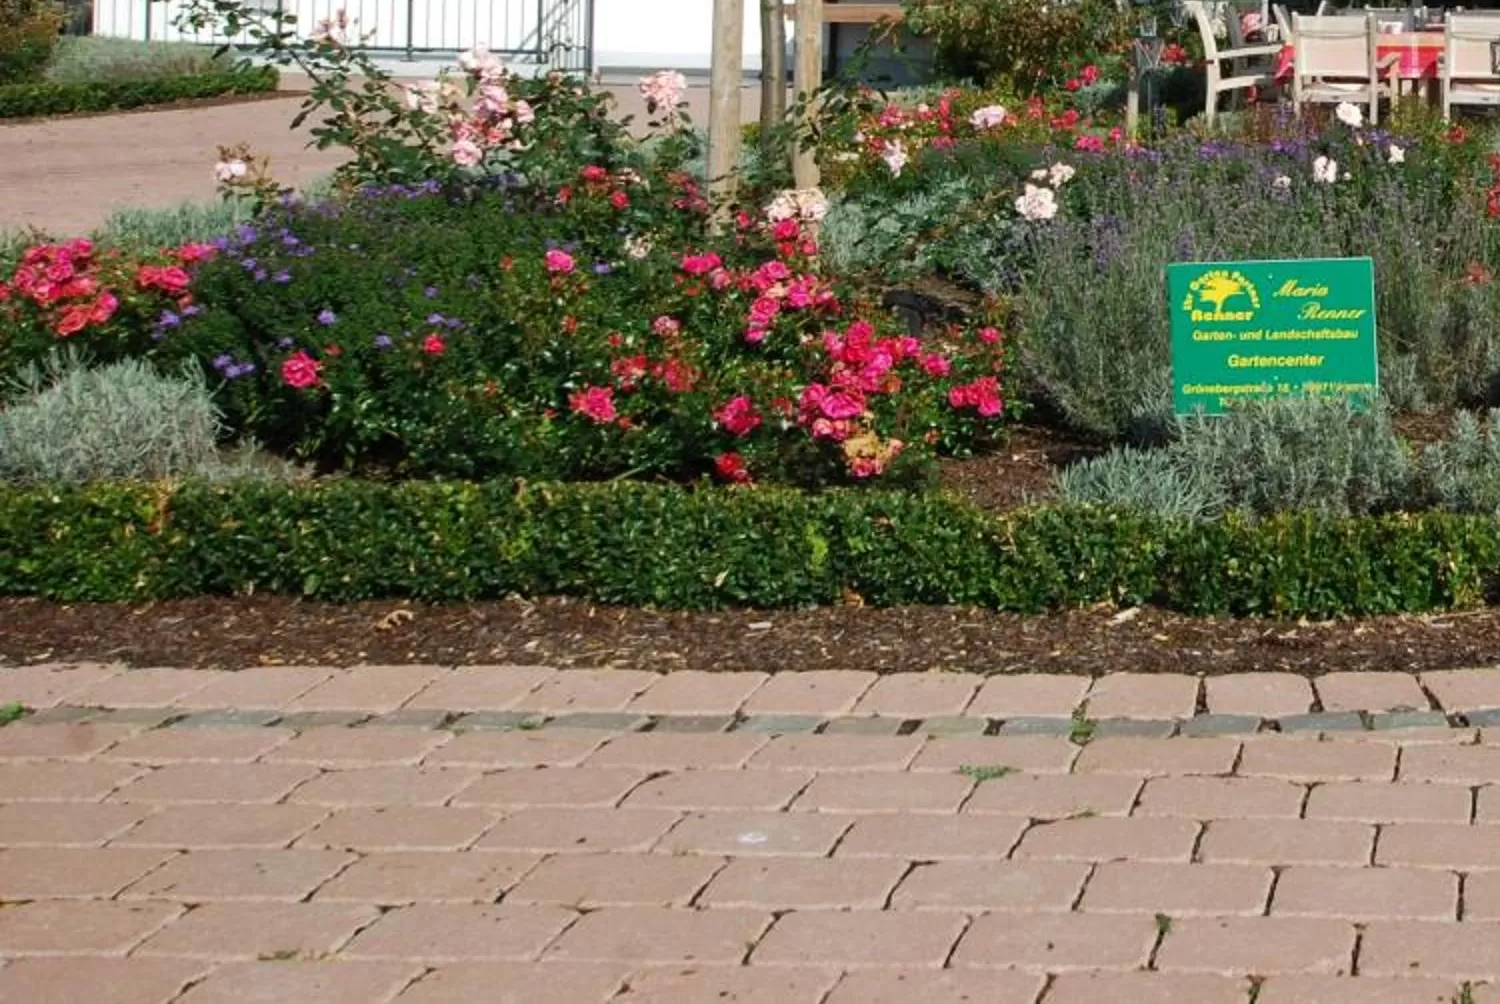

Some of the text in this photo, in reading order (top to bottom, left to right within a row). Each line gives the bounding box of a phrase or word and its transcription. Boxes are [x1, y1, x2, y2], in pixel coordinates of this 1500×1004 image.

[1191, 310, 1254, 321] Renner
[1297, 301, 1366, 320] Renner
[1192, 328, 1359, 341] Garten- und Landschaftsbau
[1227, 354, 1325, 368] Gartencenter
